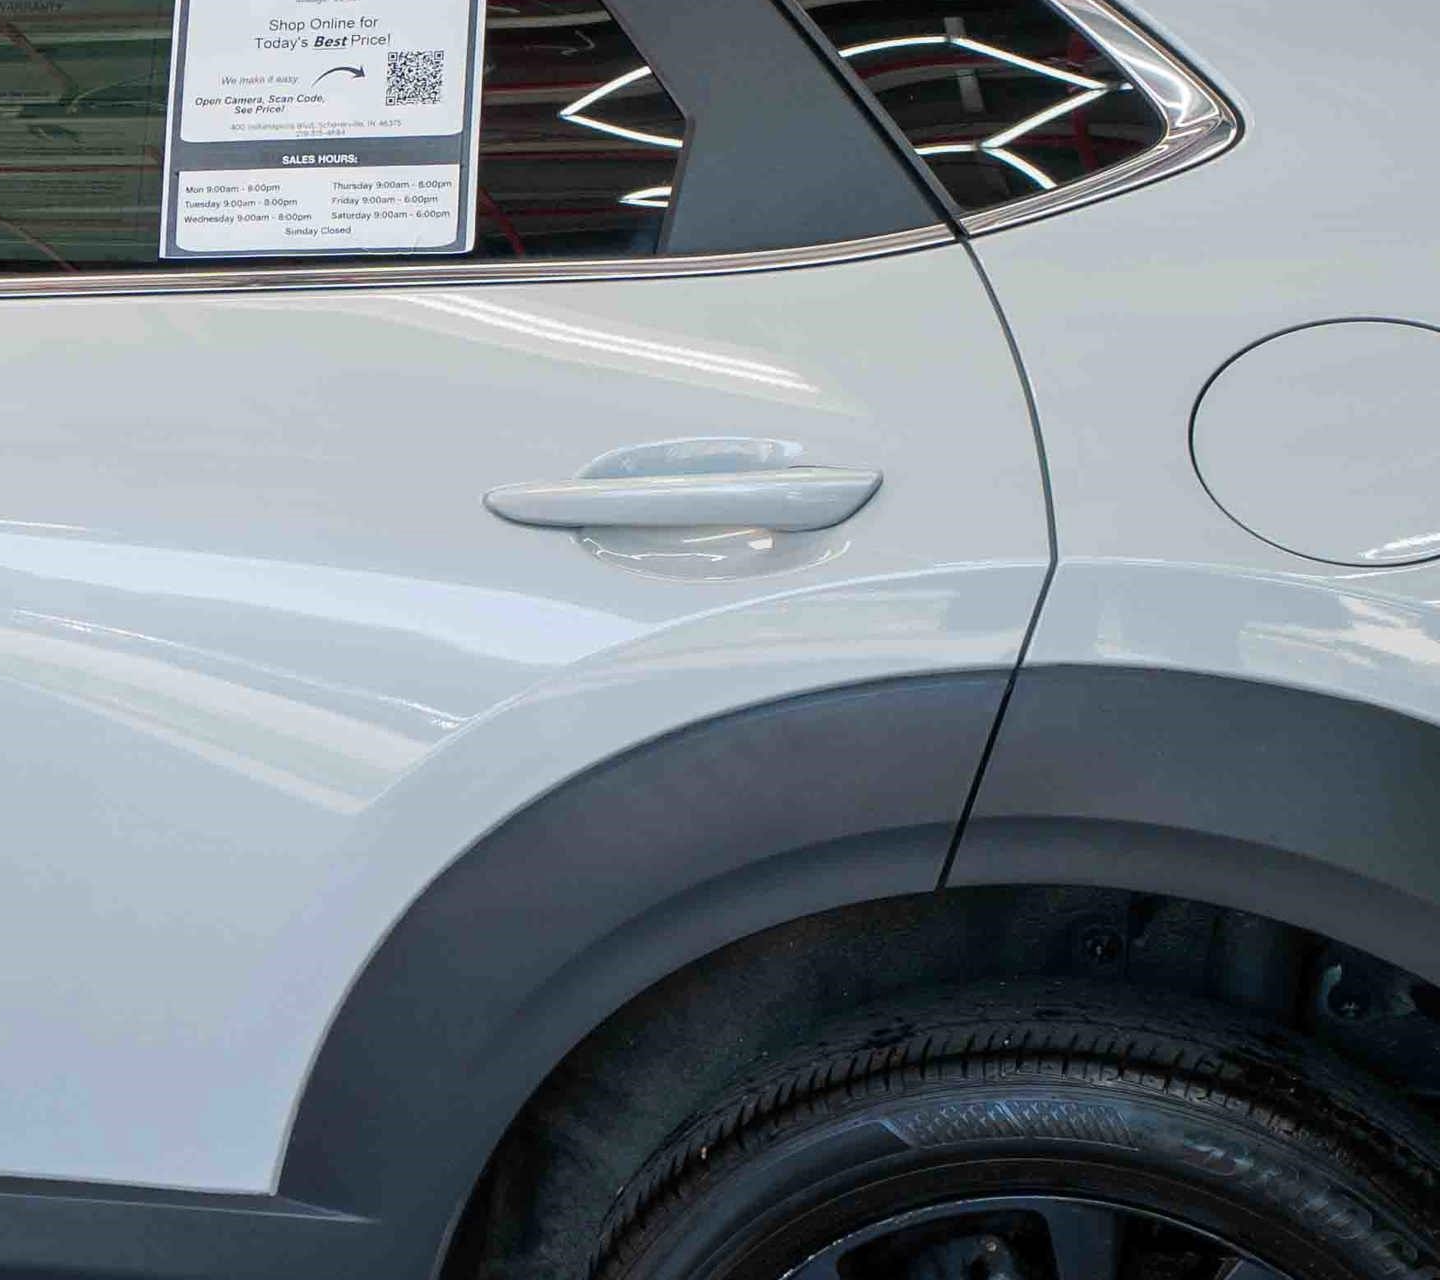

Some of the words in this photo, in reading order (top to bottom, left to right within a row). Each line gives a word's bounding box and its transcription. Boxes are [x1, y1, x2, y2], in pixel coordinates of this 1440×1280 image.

[268, 18, 306, 32] Shop
[310, 17, 356, 30] Online
[360, 16, 379, 28] for
[254, 36, 309, 51] Today's
[313, 35, 348, 50] Best
[350, 33, 391, 47] Price!
[221, 76, 237, 86] We
[194, 97, 222, 107] Open
[224, 95, 266, 106] Camera,
[268, 94, 294, 104] Scan
[296, 93, 326, 104] Code,
[234, 106, 253, 114] See
[255, 104, 285, 114] Price!
[282, 155, 316, 165] SALES
[318, 154, 358, 164] HOURS:
[185, 186, 204, 194] Mon
[206, 185, 239, 194] 9:00am
[333, 181, 373, 191] Thursday
[375, 181, 410, 189] 9:00am
[184, 200, 220, 209] Tuesday
[223, 199, 256, 208] 9:00am
[331, 197, 360, 206] Friday
[361, 195, 396, 204] 9:00am
[183, 215, 235, 224] Wednesday
[237, 214, 270, 223] 9:00am
[331, 211, 372, 221] Saturday
[373, 210, 408, 219] 9:00am
[284, 226, 319, 237] Sunday
[320, 225, 352, 235] Closed
